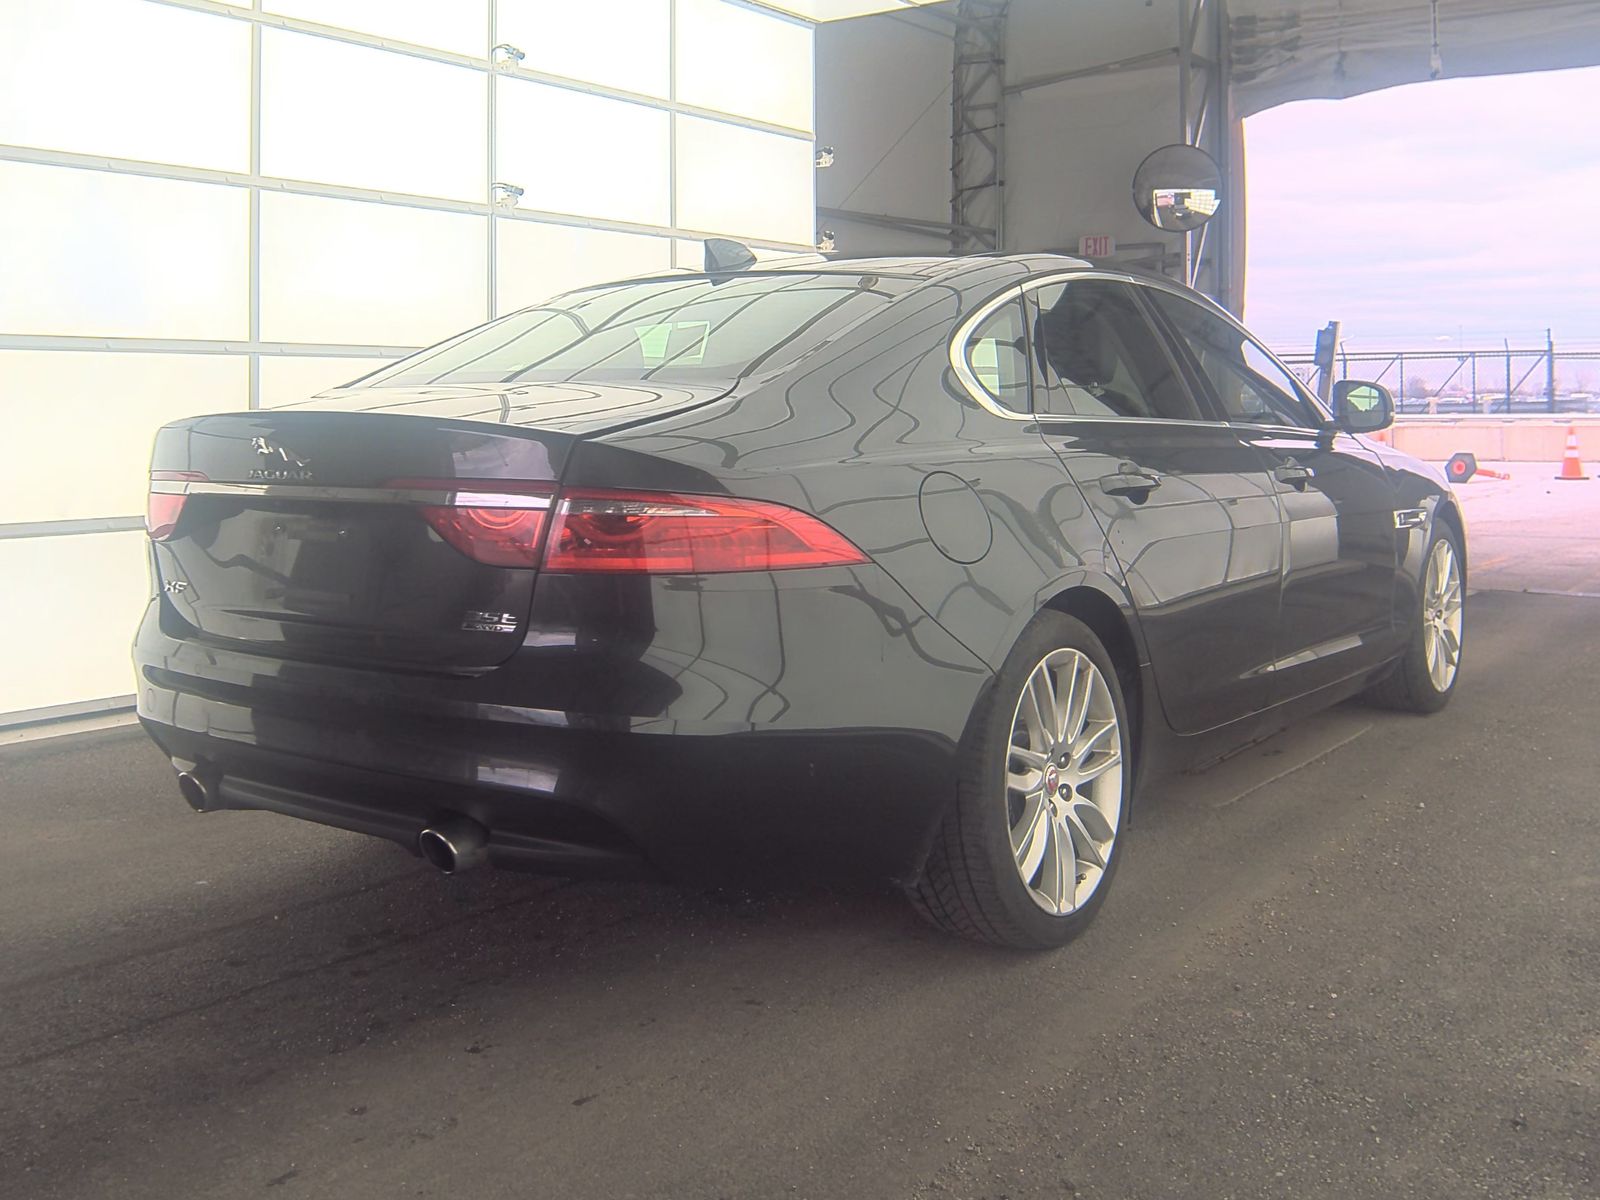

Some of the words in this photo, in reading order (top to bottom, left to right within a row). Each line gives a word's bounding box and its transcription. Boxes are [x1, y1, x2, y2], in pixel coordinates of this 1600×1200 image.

[1084, 236, 1109, 257] EXIT
[248, 470, 312, 480] JAGUAR
[164, 580, 187, 593] XF
